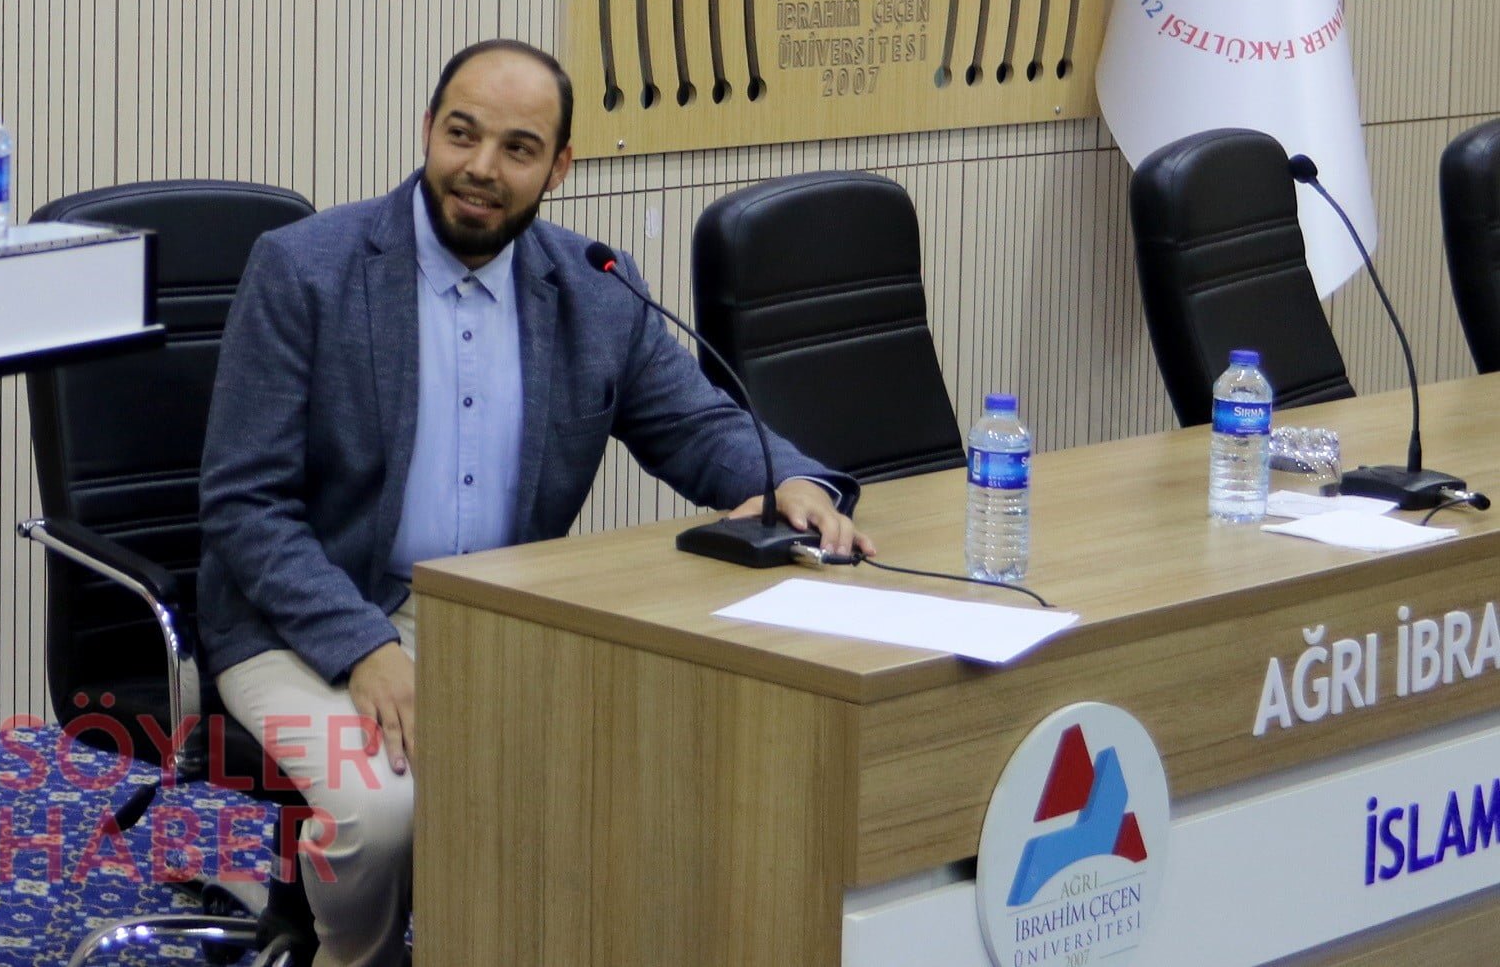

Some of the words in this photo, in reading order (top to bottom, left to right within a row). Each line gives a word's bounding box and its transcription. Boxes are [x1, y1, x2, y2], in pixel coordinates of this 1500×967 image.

[778, 25, 927, 70] ÜNİVERSİTESİ
[1158, 13, 1295, 64] FAKÜLTESİ
[822, 66, 880, 97] 2007
[1252, 624, 1378, 737] AĞRI
[1396, 602, 1500, 697] İBRA
[1364, 777, 1500, 886] İSLAM
[1060, 870, 1098, 900] AĞRI
[1014, 909, 1141, 967] ÜNİVERSİTESİ
[1015, 901, 1086, 943] İBRAHİM
[1089, 882, 1141, 922] ÇEÇEN
